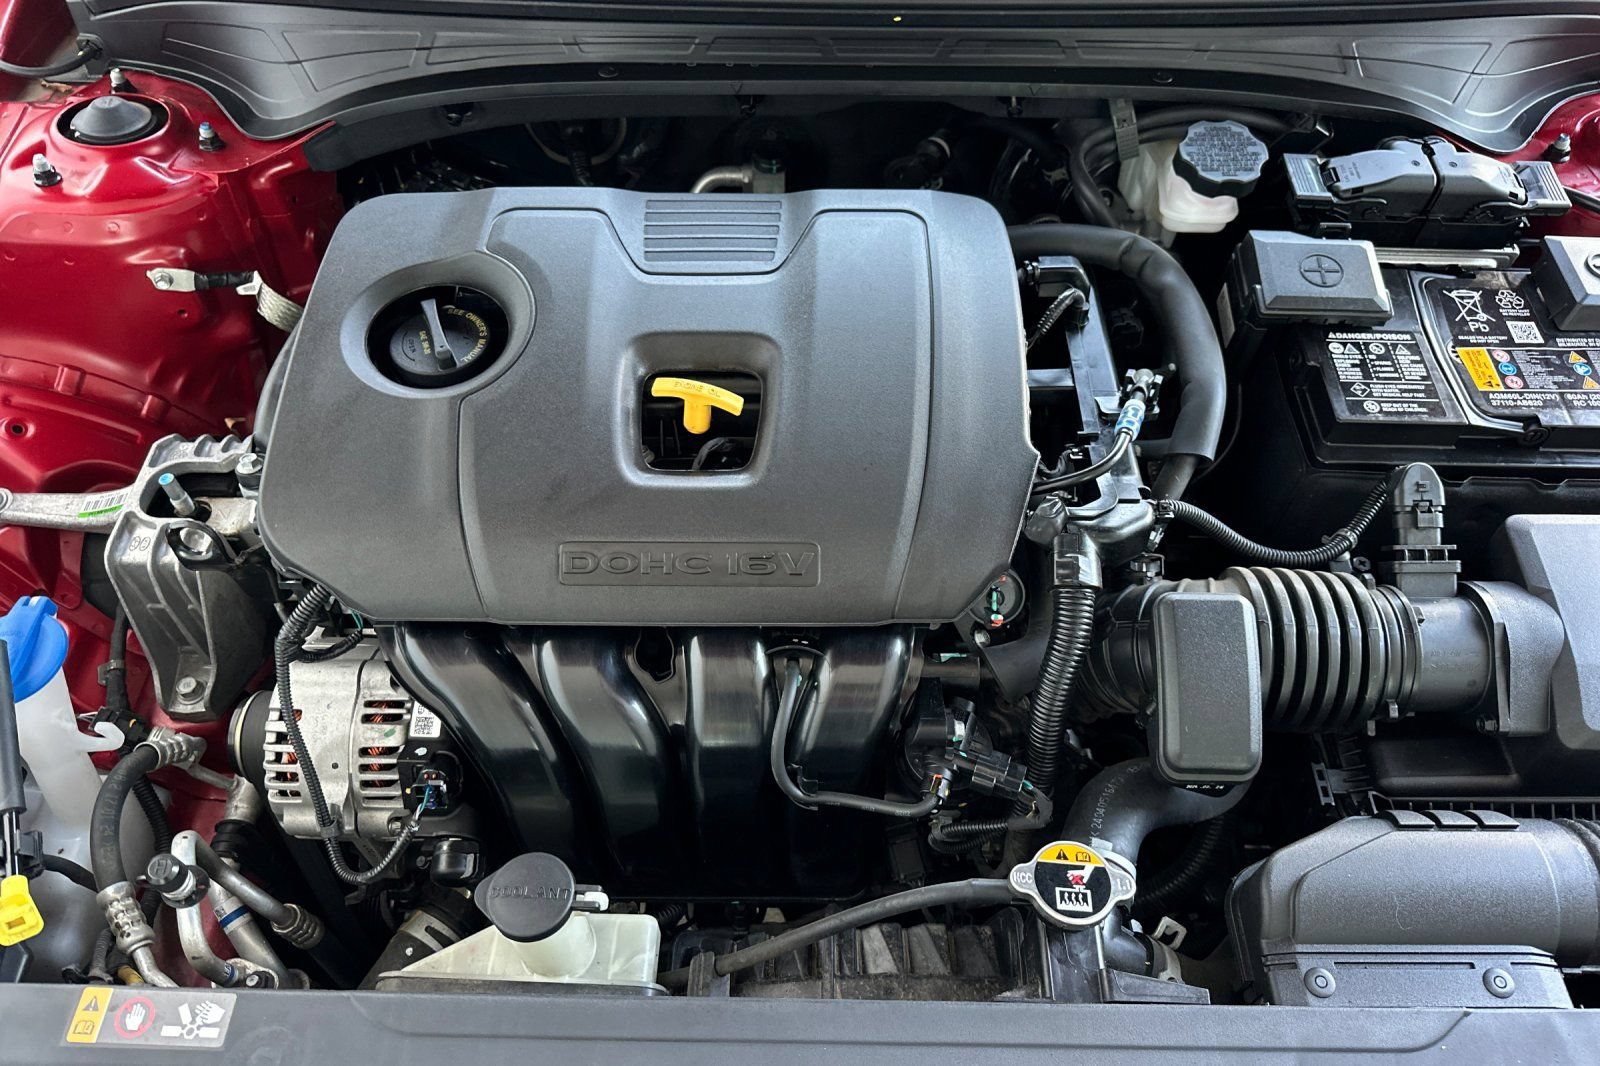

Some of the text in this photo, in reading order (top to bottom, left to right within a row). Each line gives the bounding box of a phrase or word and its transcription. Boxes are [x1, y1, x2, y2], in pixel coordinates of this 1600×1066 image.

[1468, 321, 1490, 332] Pb
[448, 308, 487, 362] SEE OWNER'S MANUAL
[1335, 332, 1411, 340] DANGER/POISON
[563, 552, 815, 576] DOHC 16V
[489, 885, 572, 901] COOLANT
